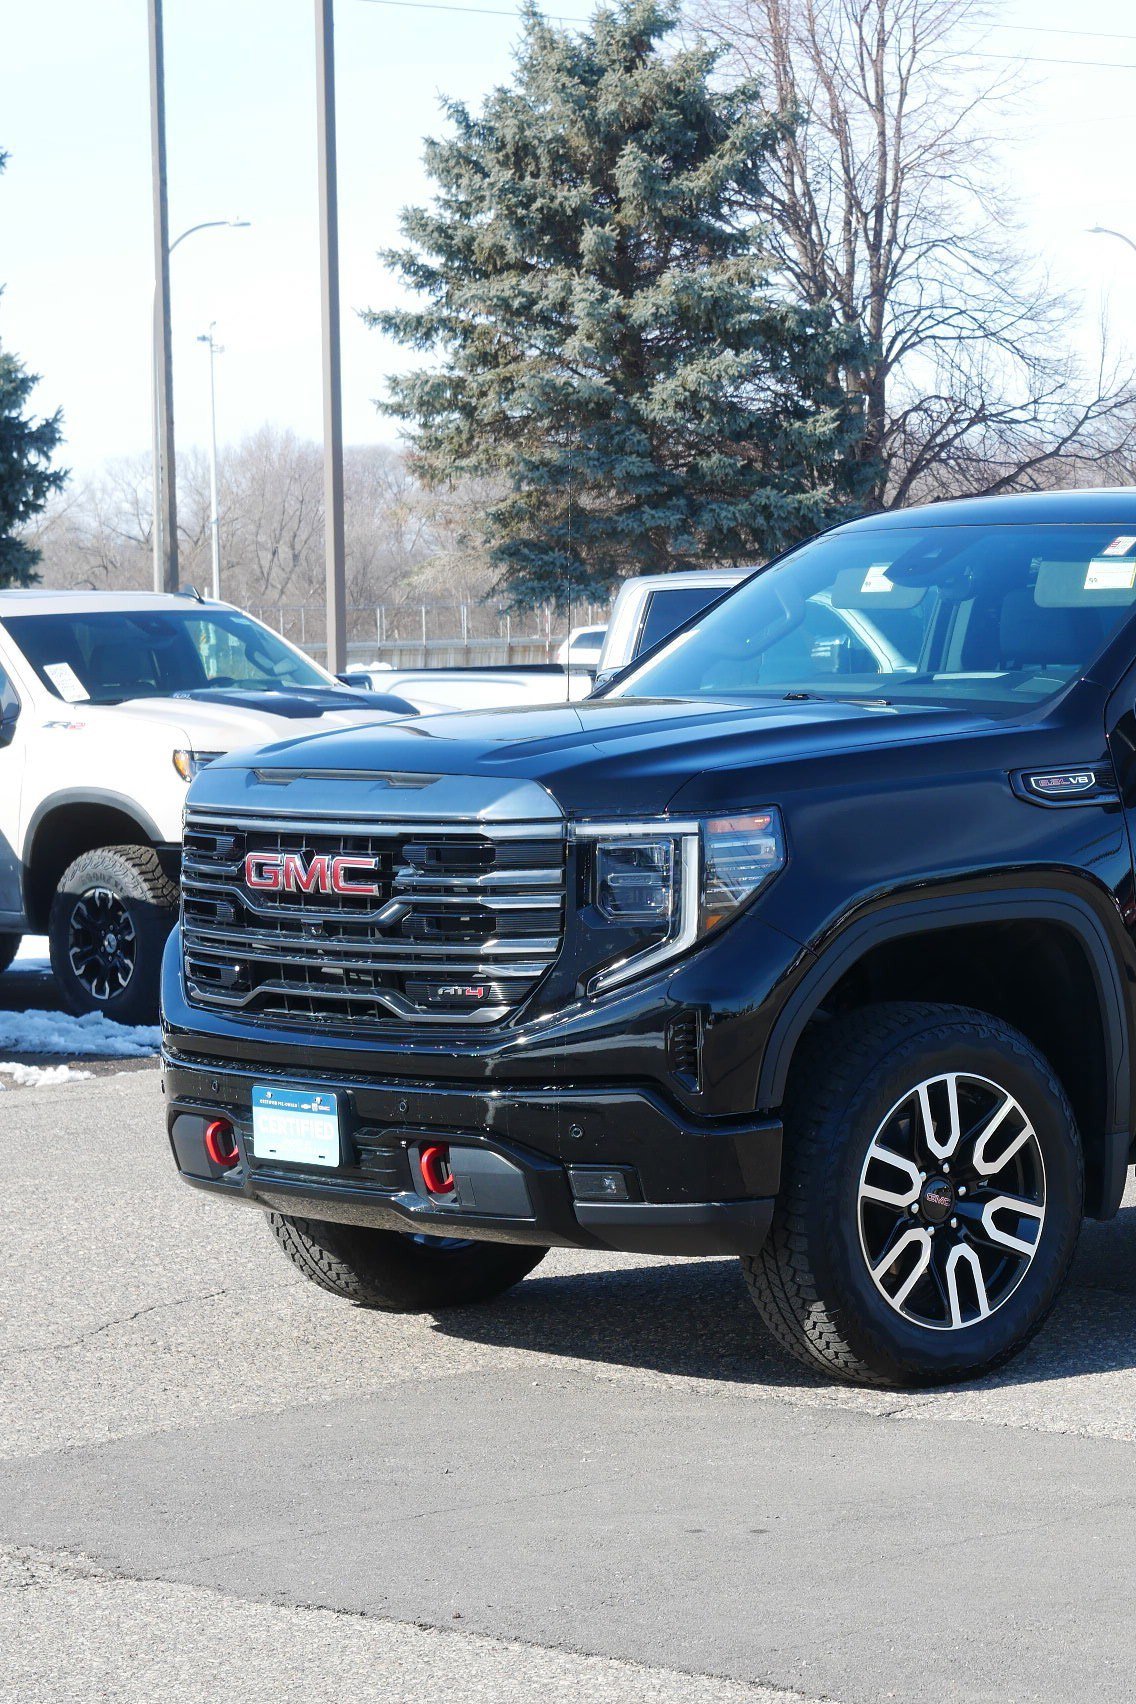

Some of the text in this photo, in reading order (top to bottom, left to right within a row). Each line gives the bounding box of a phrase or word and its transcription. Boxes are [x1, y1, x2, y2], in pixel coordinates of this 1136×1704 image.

[245, 851, 380, 897] GMC
[437, 986, 484, 999] AT4
[258, 1114, 335, 1141] CERTIFIED
[926, 1192, 952, 1207] GMC
